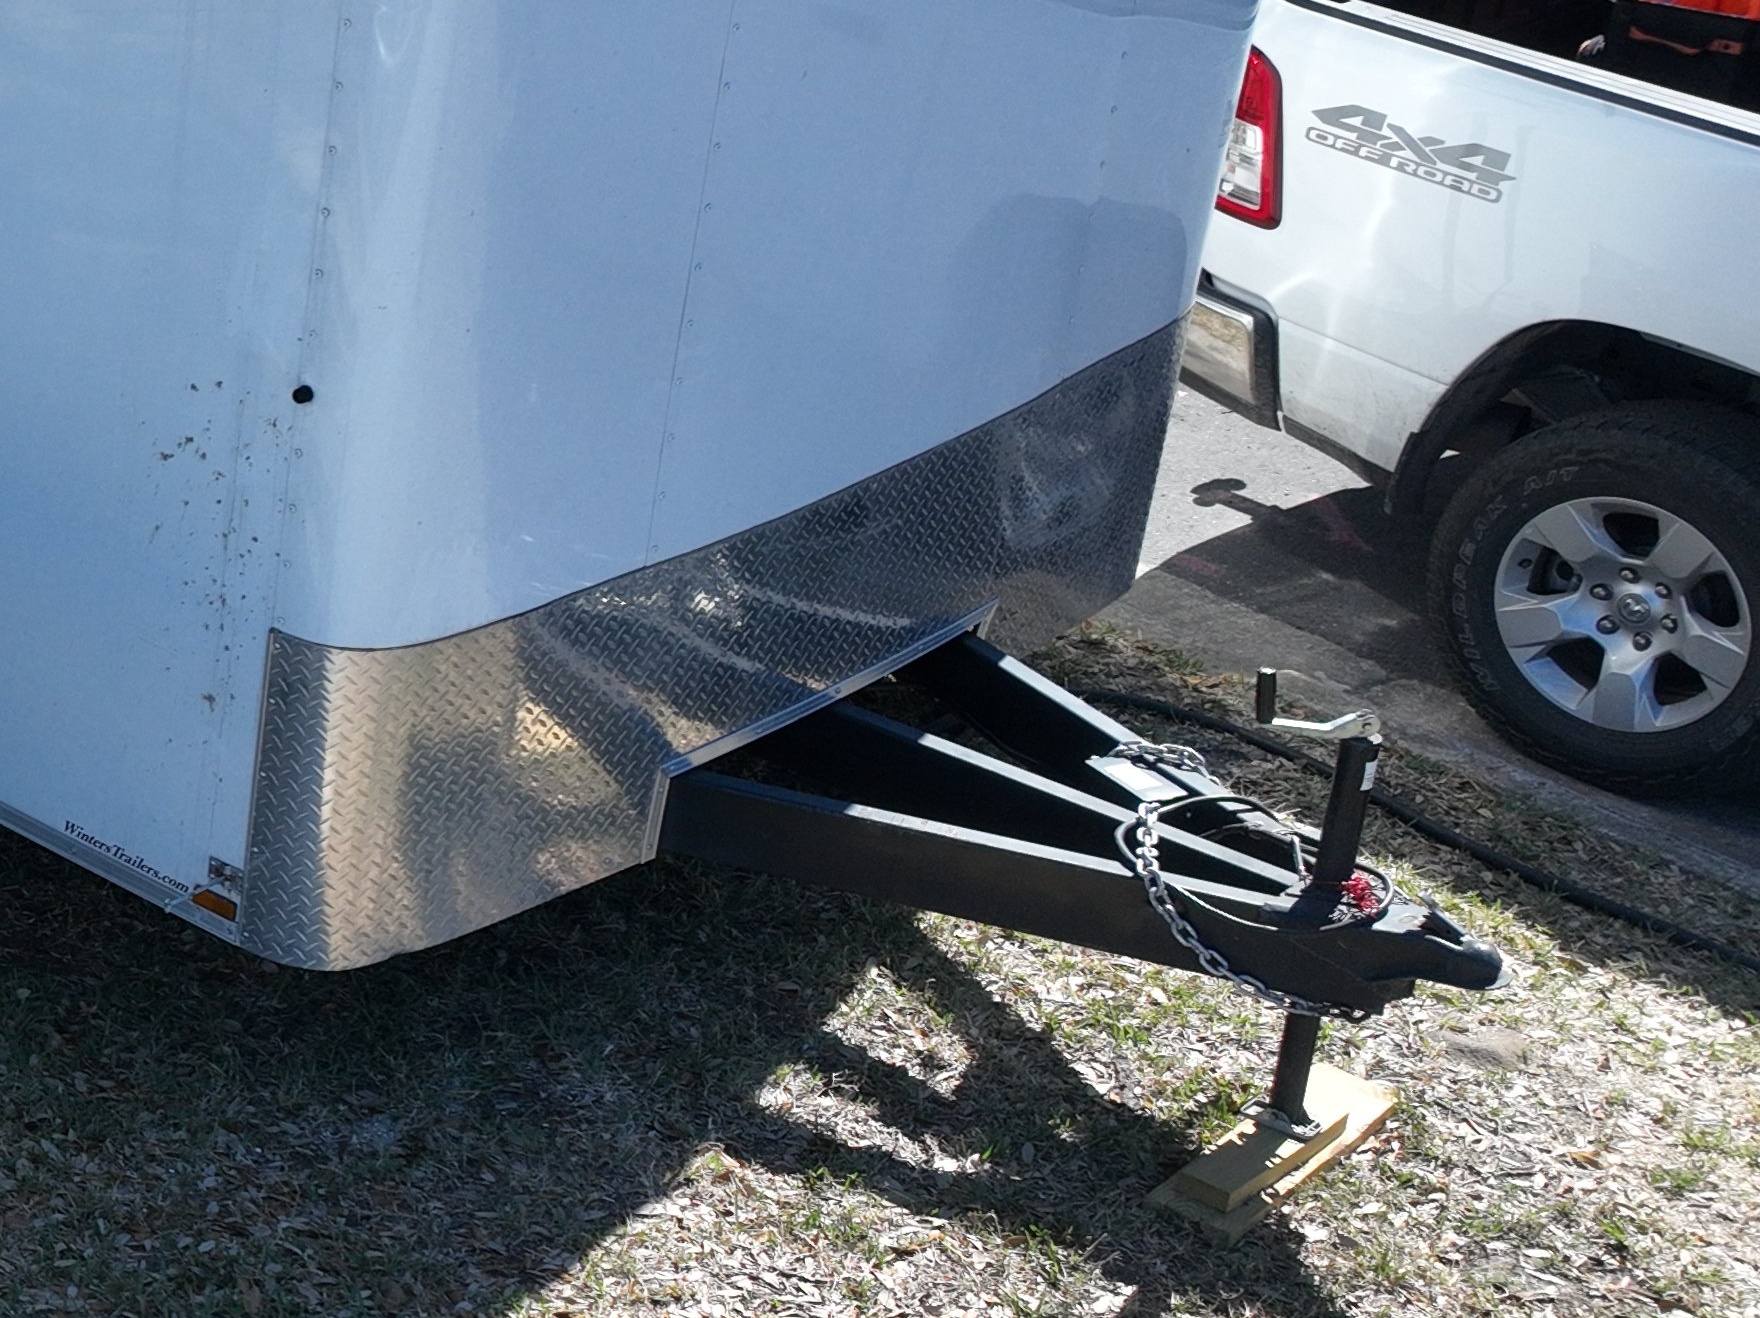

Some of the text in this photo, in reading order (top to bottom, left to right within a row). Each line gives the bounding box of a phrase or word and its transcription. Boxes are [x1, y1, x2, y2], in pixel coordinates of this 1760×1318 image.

[1308, 129, 1500, 203] OFF ROAD
[63, 820, 190, 893] WintersTrailers.com
